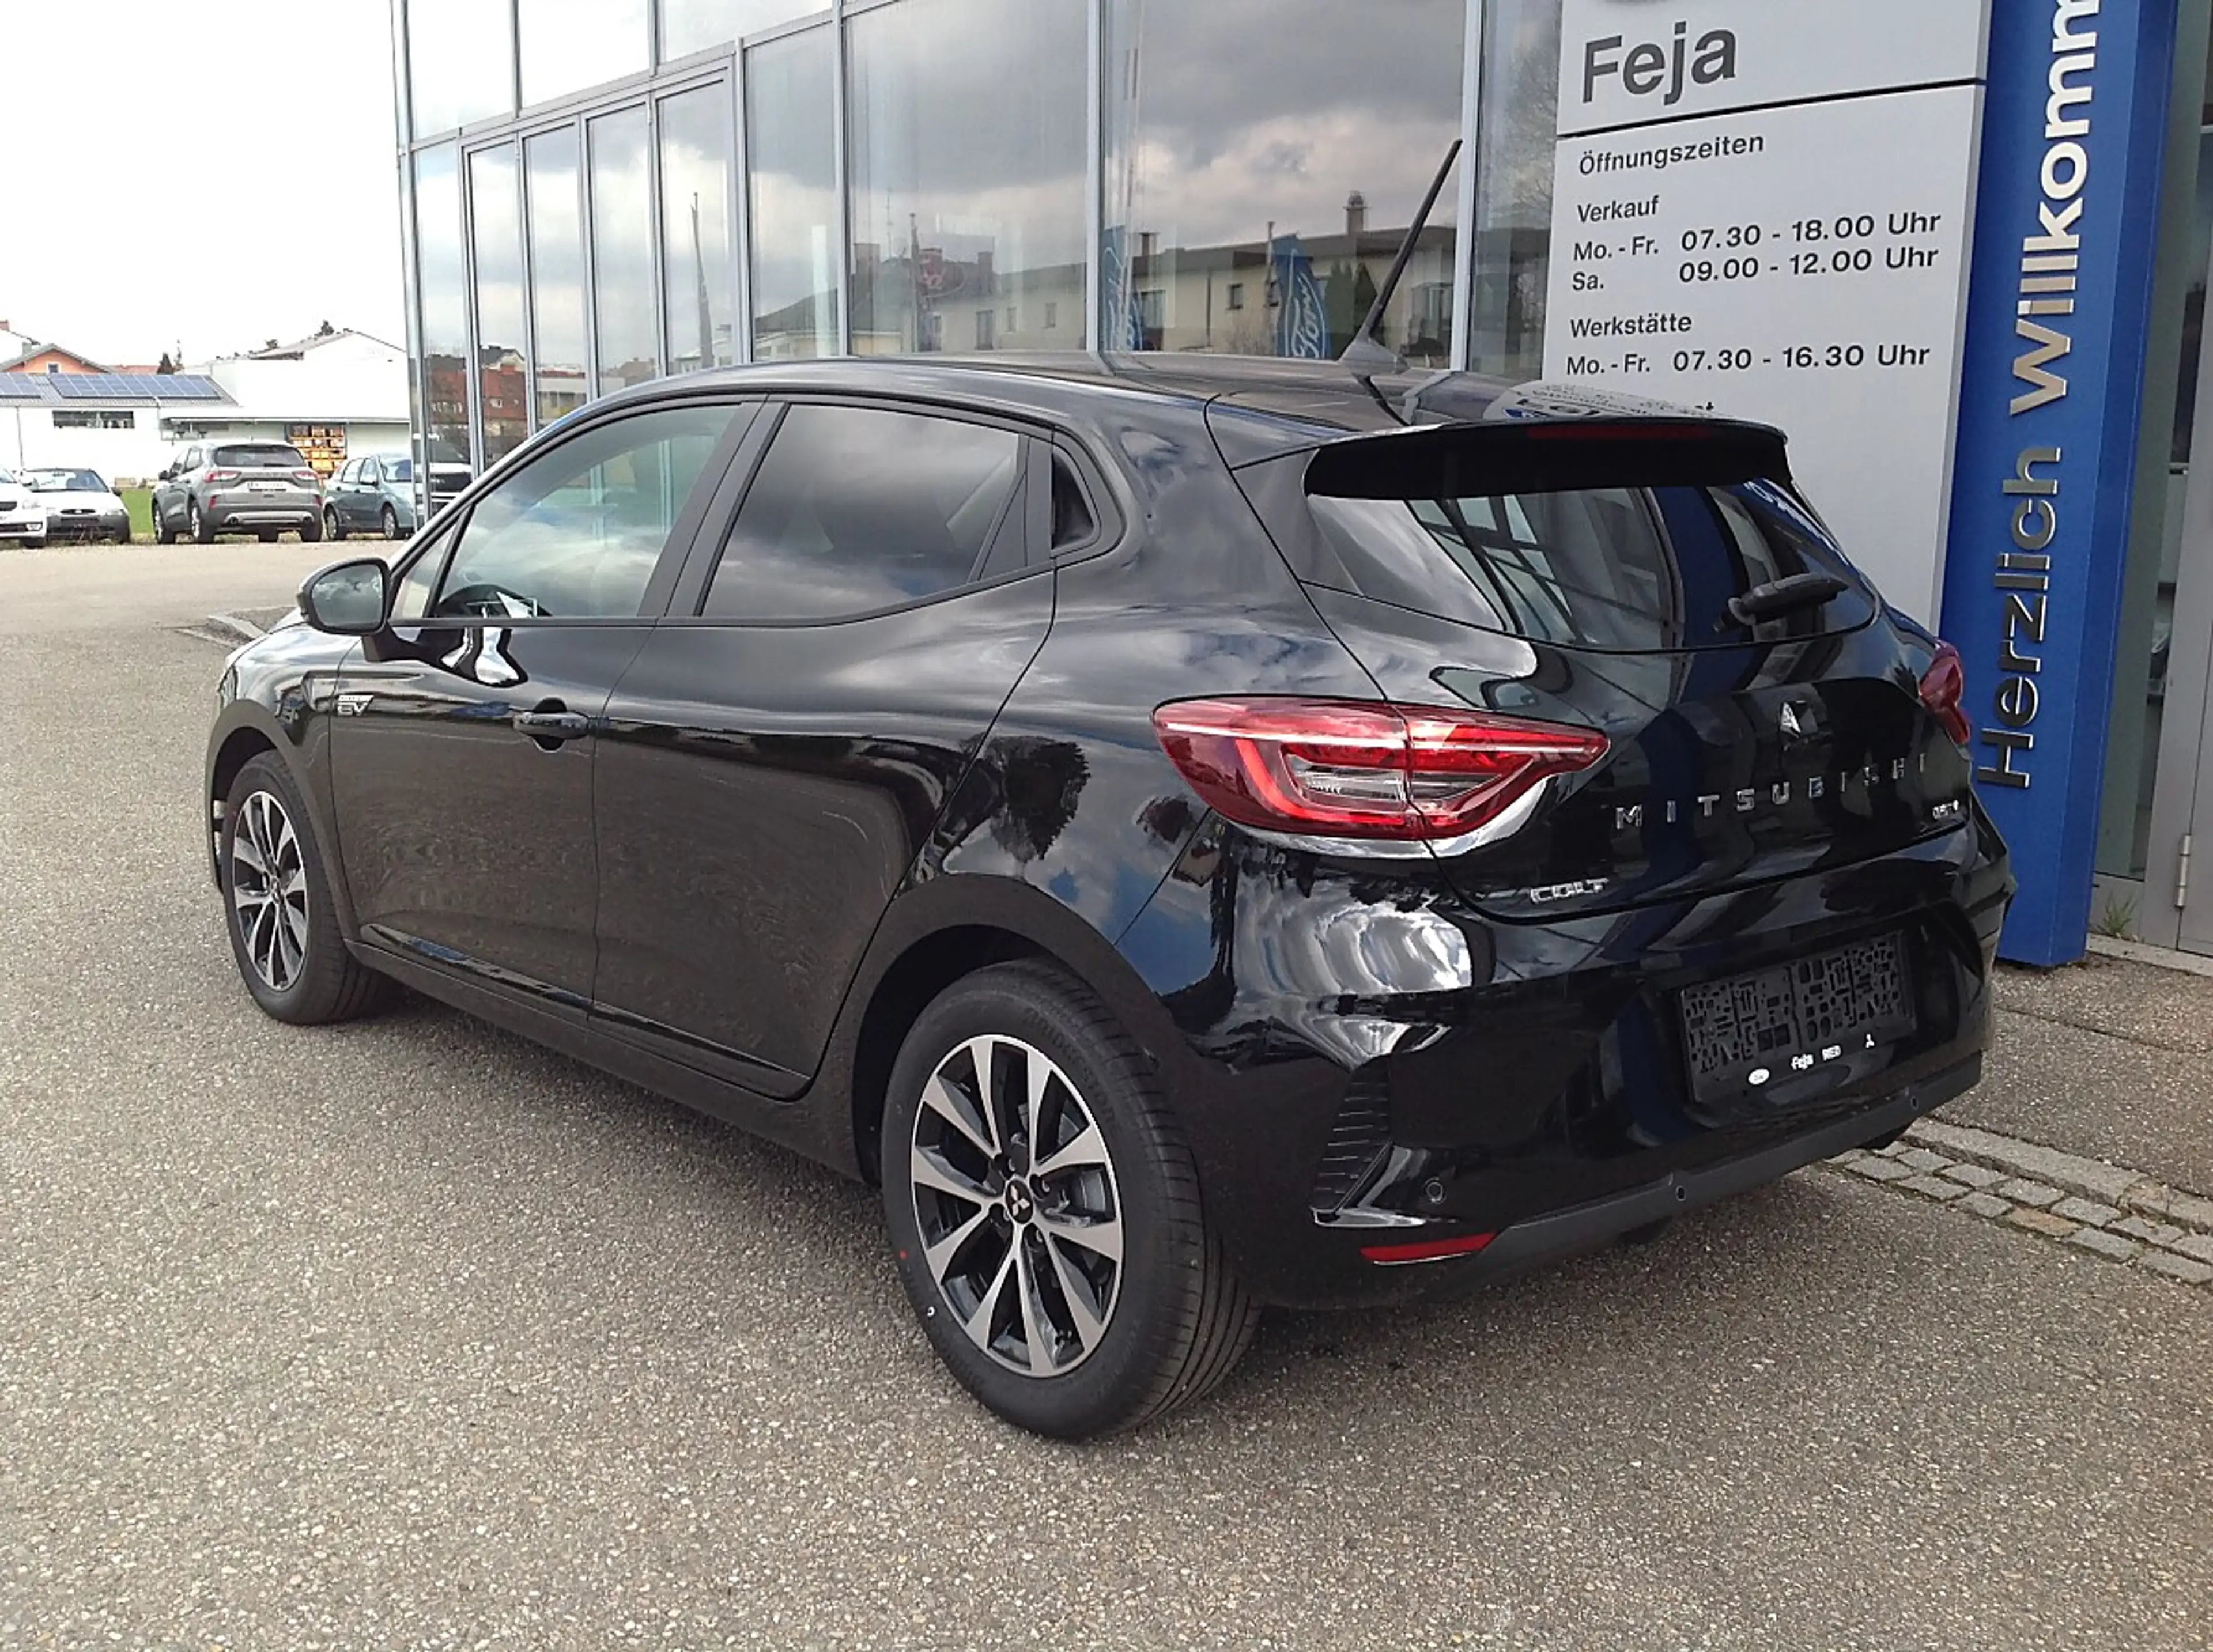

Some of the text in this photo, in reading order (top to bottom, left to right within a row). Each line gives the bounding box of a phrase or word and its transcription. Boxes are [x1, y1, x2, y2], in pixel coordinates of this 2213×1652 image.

[1583, 20, 1736, 106] Feja
[1579, 135, 1764, 176] Öffnungszeiten
[1577, 194, 1660, 224] Verkauf
[1573, 240, 1613, 262] Mo.
[1631, 235, 1659, 256] Fr.
[1681, 224, 1762, 252] 07.30
[1791, 214, 1875, 243] 18.00
[1887, 211, 1942, 236] Uhr
[1572, 271, 1604, 292] Sa.
[1679, 256, 1759, 283] 09.00
[1789, 248, 1872, 277] 12.00
[1885, 245, 1939, 270] Uhr
[1570, 312, 1693, 338] Werkstätte
[1566, 355, 1606, 376] Mo.
[1623, 353, 1651, 373] Fr.
[1673, 347, 1753, 373] 07.30
[1782, 344, 1864, 369] 16.30
[1877, 343, 1931, 367] Uhr
[1977, 447, 2060, 788] Herzlich
[1616, 754, 1927, 829] MITSUBISHI
[1530, 877, 1609, 905] COLT
